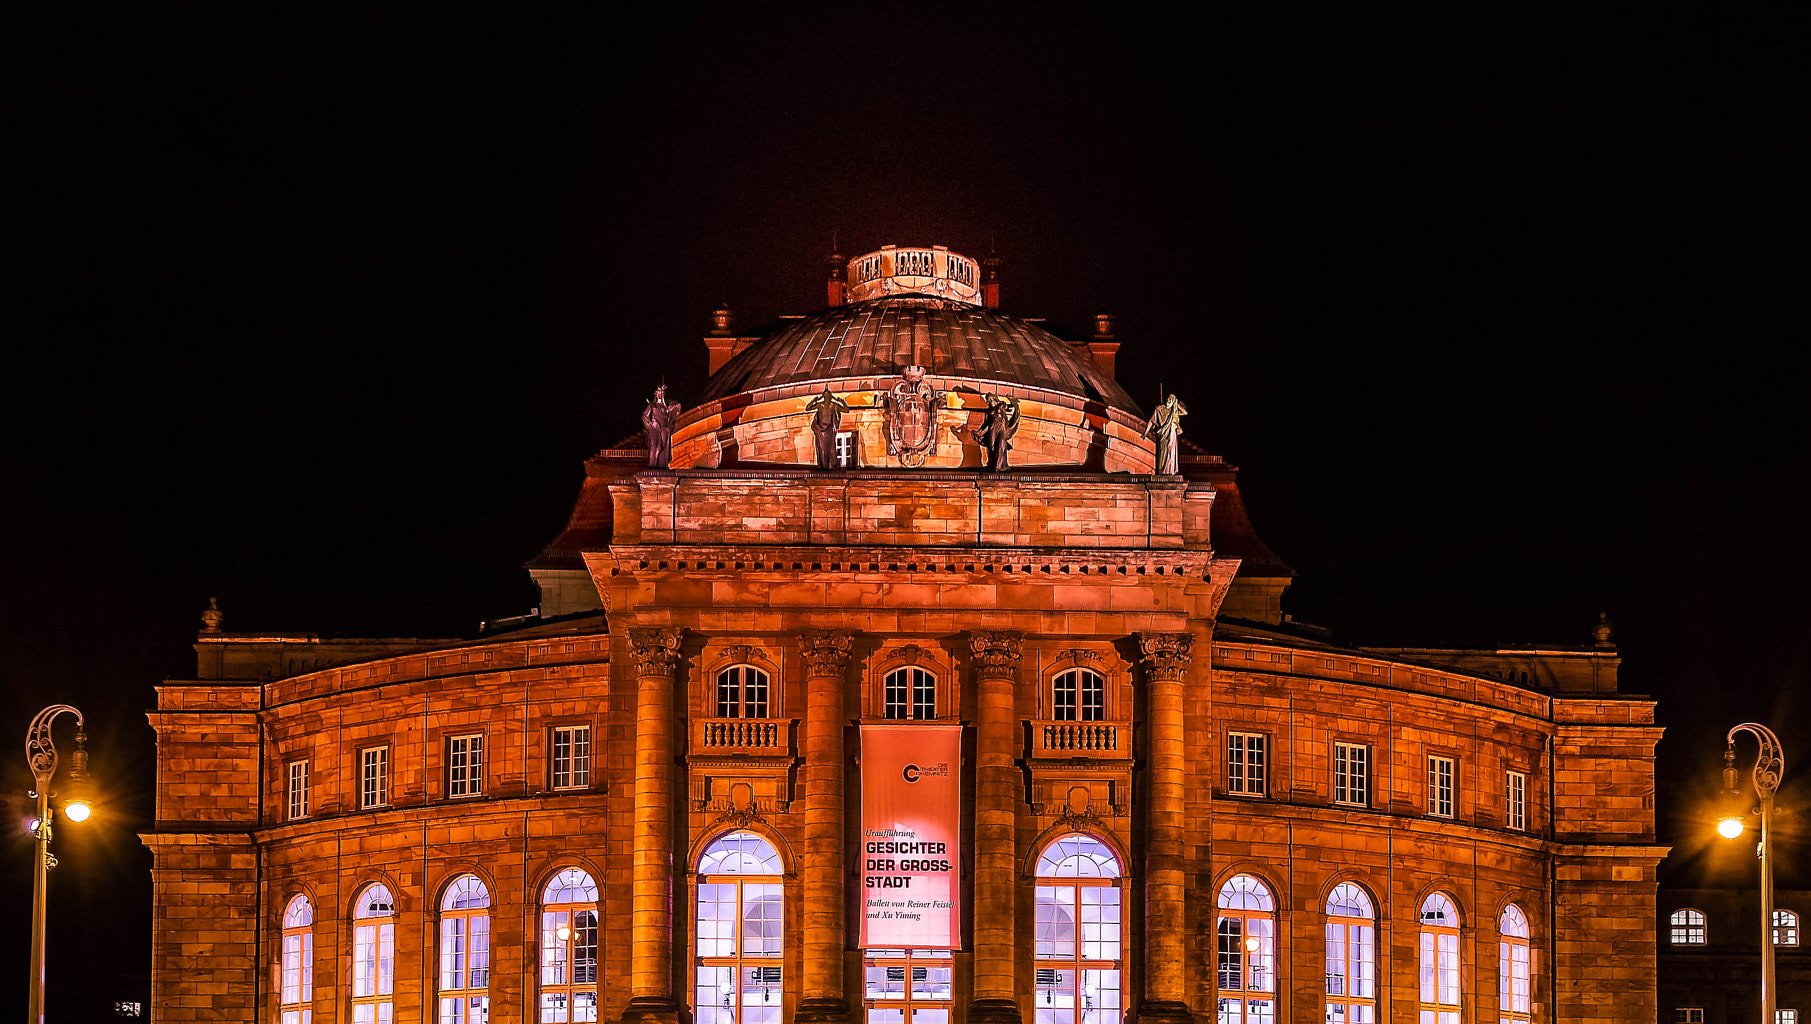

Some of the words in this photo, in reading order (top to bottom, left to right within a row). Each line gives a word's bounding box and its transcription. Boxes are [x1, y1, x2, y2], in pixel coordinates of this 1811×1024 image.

[865, 829, 915, 838] Uraufführung
[866, 841, 946, 854] GESICHTER
[866, 859, 895, 871] DER
[900, 859, 953, 872] GROSS-
[865, 876, 911, 888] STADT
[866, 899, 889, 907] Ballett
[907, 900, 931, 908] Reiner
[932, 900, 955, 909] Feistel
[865, 911, 880, 919] und
[881, 911, 893, 919] Xu
[895, 911, 921, 921] Yiming
